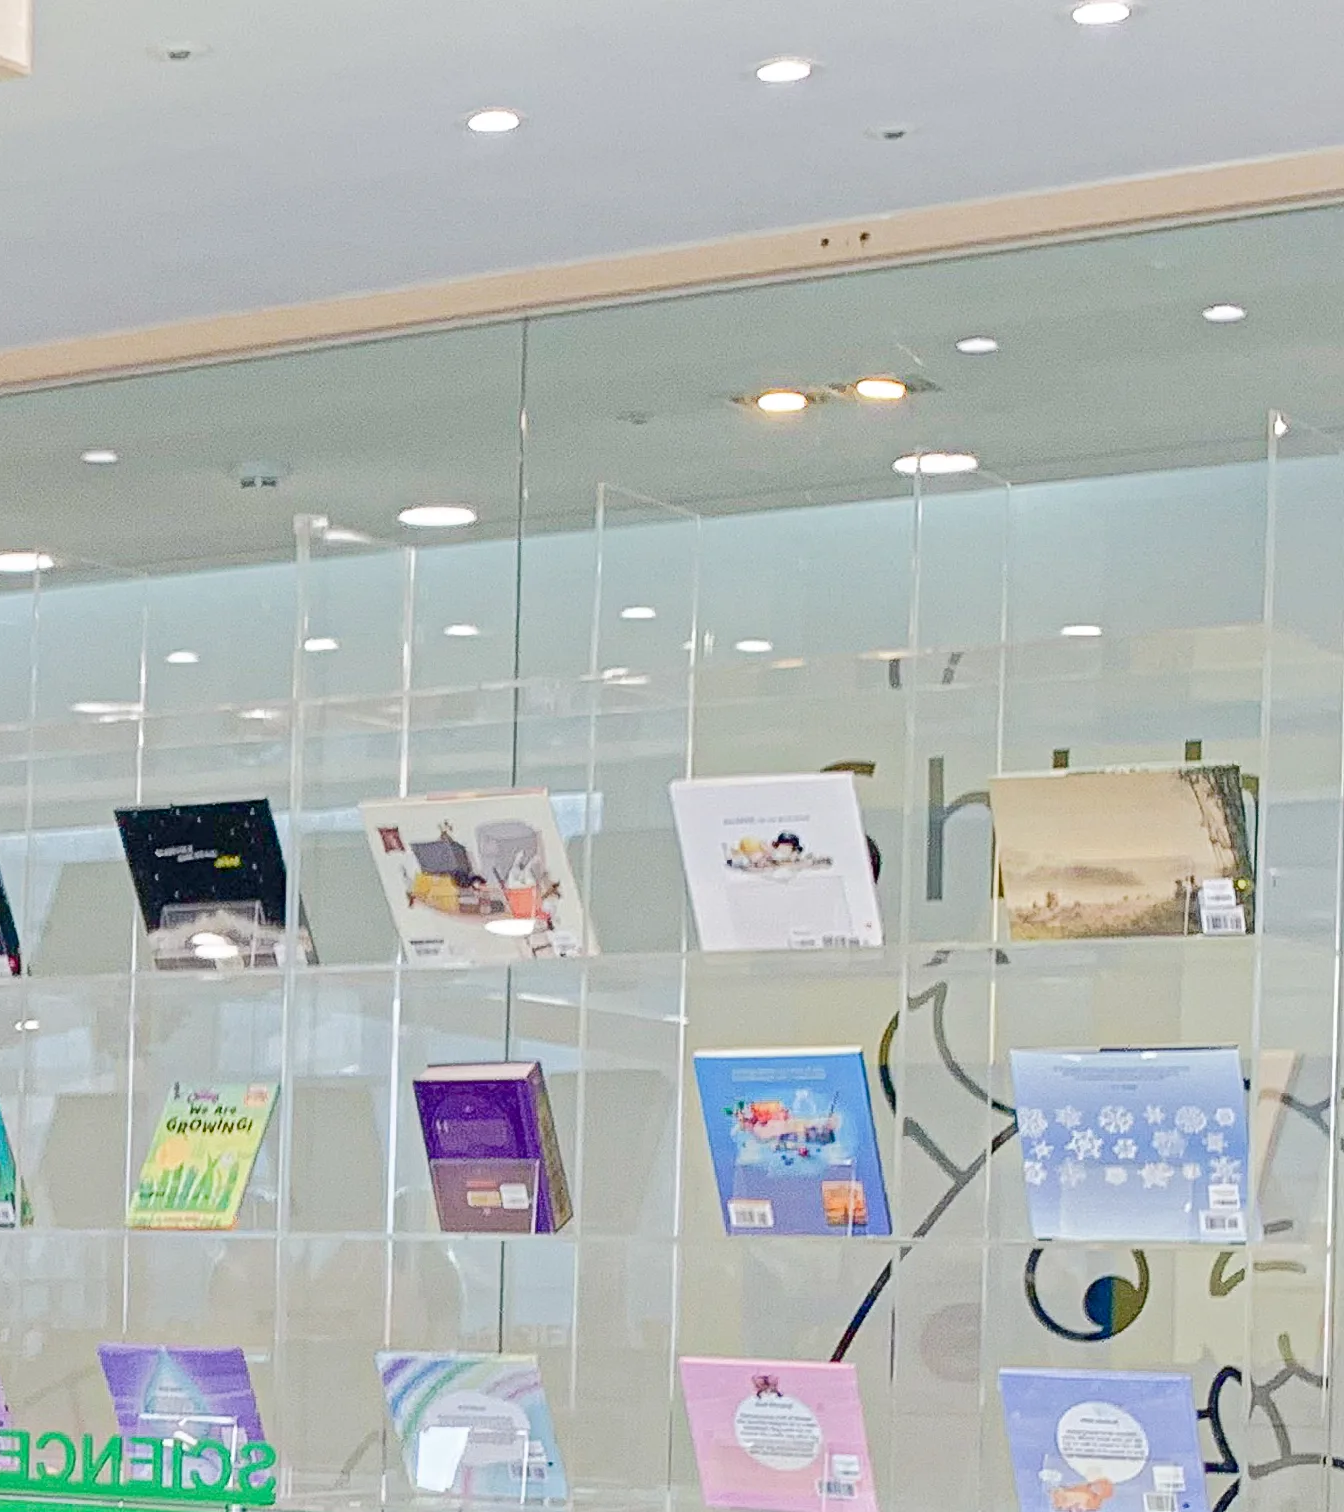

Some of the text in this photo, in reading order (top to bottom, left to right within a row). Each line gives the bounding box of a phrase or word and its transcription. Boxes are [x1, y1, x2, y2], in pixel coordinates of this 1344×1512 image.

[189, 1103, 237, 1115] We Are
[166, 1116, 254, 1134] GROWING!
